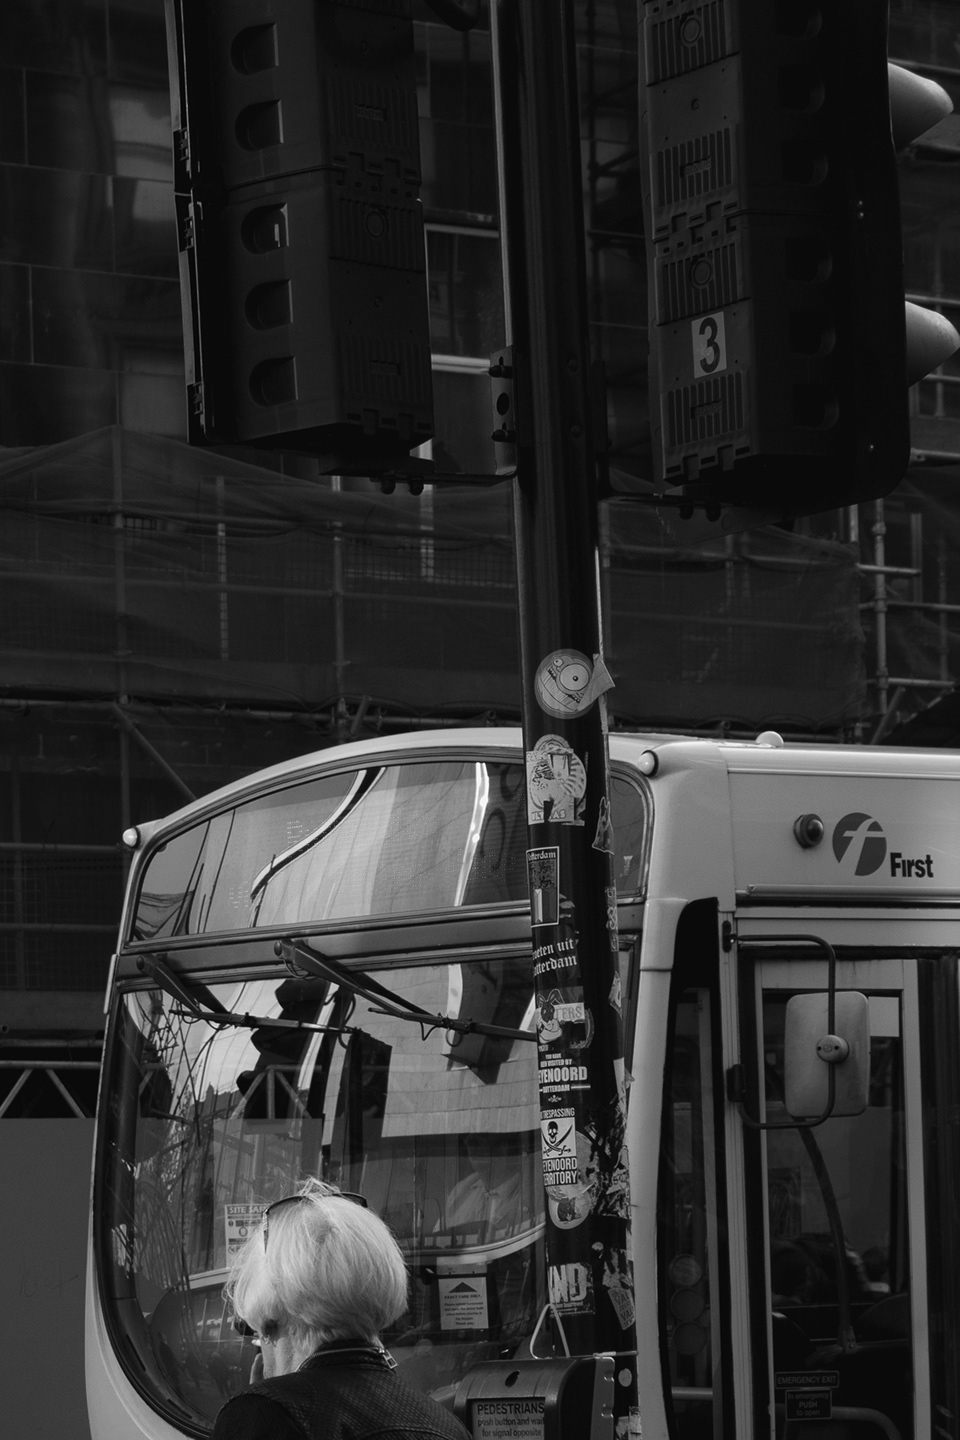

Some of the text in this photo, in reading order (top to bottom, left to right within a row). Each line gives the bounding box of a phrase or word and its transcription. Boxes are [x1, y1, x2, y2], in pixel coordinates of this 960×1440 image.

[700, 318, 719, 373] 3
[890, 852, 934, 877] First
[557, 938, 575, 951] uit
[533, 956, 577, 977] otterdam
[538, 1066, 588, 1084] EYENOORD
[542, 1158, 578, 1173] EYENOORD
[543, 1171, 578, 1186] ERRITORY
[777, 1375, 837, 1385] EMERGENCY EXIT
[795, 1392, 829, 1401] emergency
[477, 1402, 545, 1415] PEDESTRIANS
[798, 1401, 818, 1409] PUSH
[804, 1409, 820, 1417] open
[478, 1417, 493, 1428] push
[494, 1416, 516, 1426] button
[517, 1416, 530, 1426] and
[481, 1426, 542, 1438] for signal opposite
